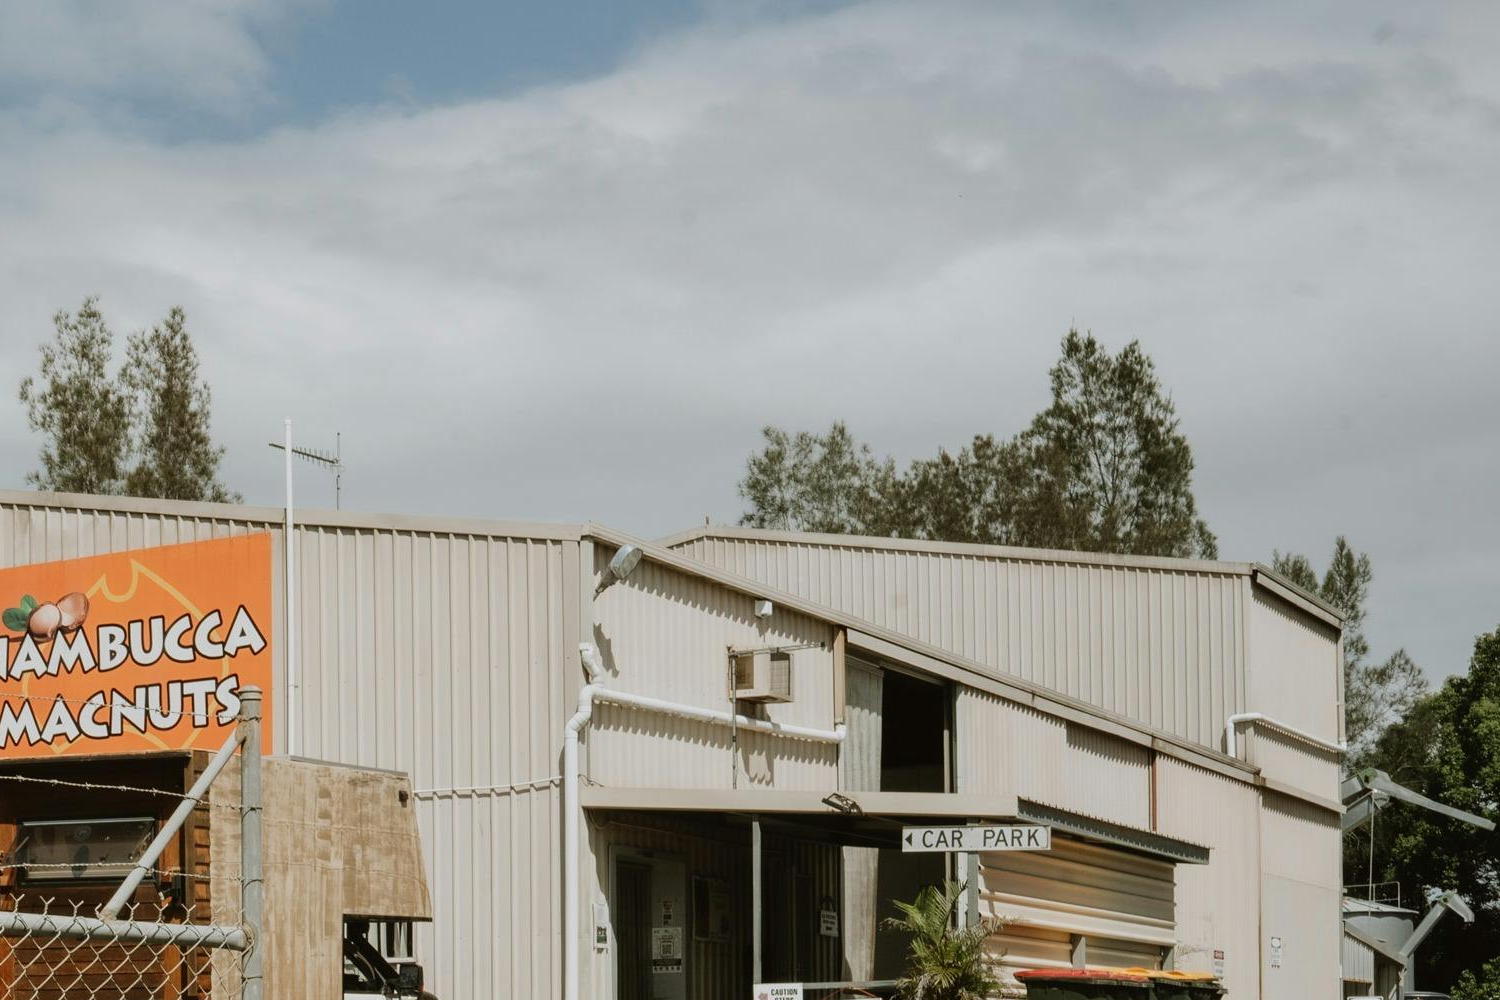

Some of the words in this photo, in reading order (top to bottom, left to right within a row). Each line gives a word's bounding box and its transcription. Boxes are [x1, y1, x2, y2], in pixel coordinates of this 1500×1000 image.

[922, 830, 963, 848] CAR
[983, 829, 1040, 847] PARK
[770, 988, 798, 996] CAUTION
